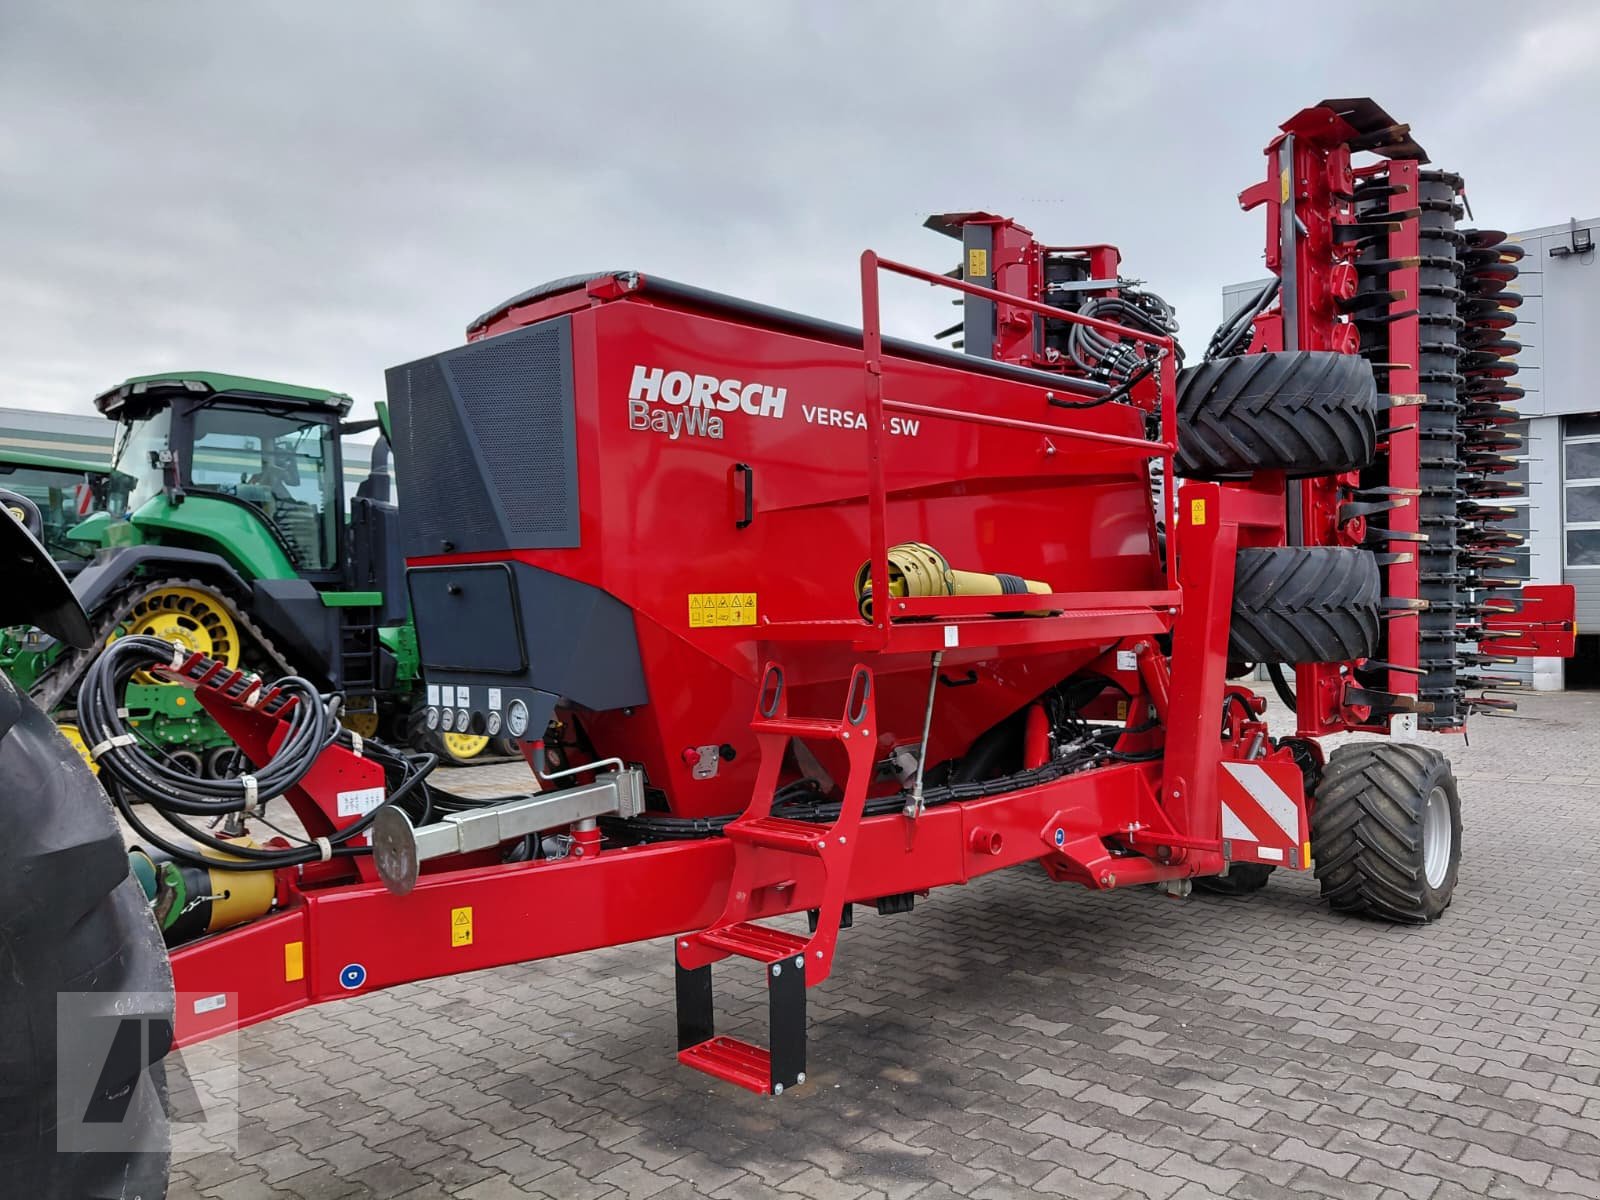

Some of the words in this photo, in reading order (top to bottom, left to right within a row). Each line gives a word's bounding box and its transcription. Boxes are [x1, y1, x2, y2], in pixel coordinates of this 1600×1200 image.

[628, 365, 788, 419] HORSCH
[628, 400, 725, 440] BayWa
[801, 404, 868, 431] VERSA
[890, 417, 920, 437] SW
